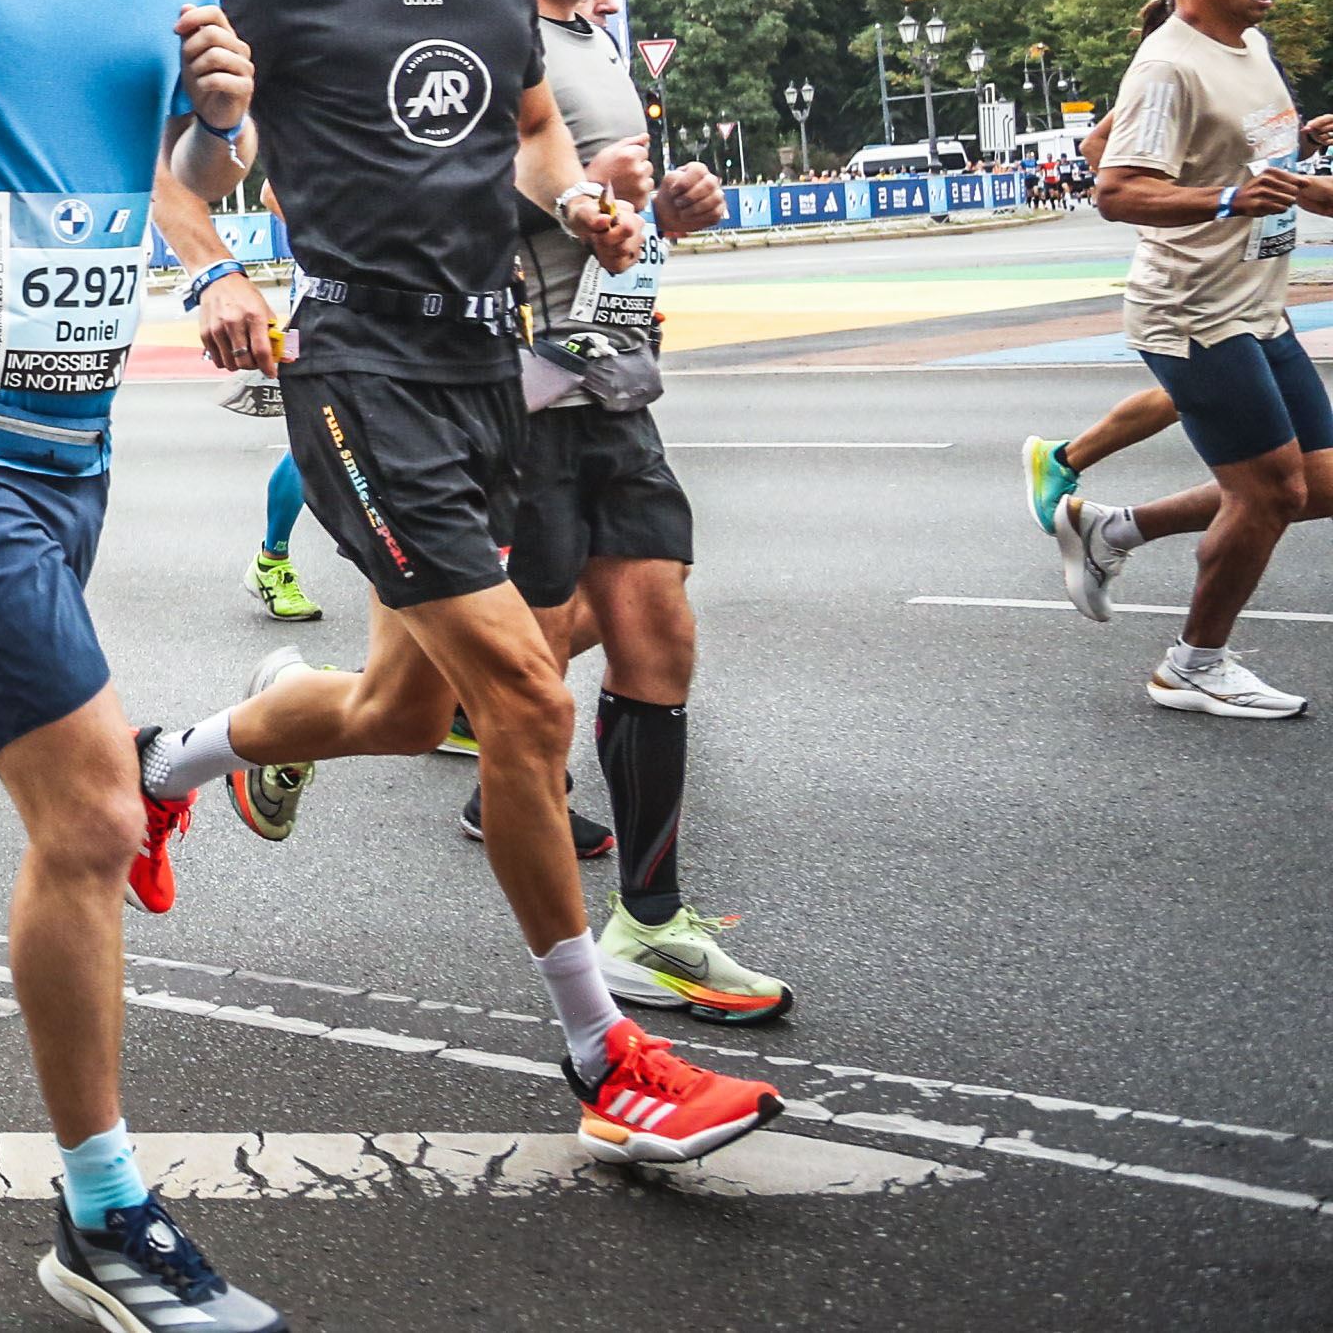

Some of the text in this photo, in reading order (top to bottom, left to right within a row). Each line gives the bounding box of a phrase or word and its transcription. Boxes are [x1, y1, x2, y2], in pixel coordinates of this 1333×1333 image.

[22, 264, 138, 308] 62927
[600, 296, 653, 311] IMPOSSIBLE
[595, 311, 649, 325] IS NOTHING
[56, 319, 119, 343] Daniel
[7, 353, 109, 372] IMPOSSIBLE
[4, 372, 104, 392] IS NOTHING
